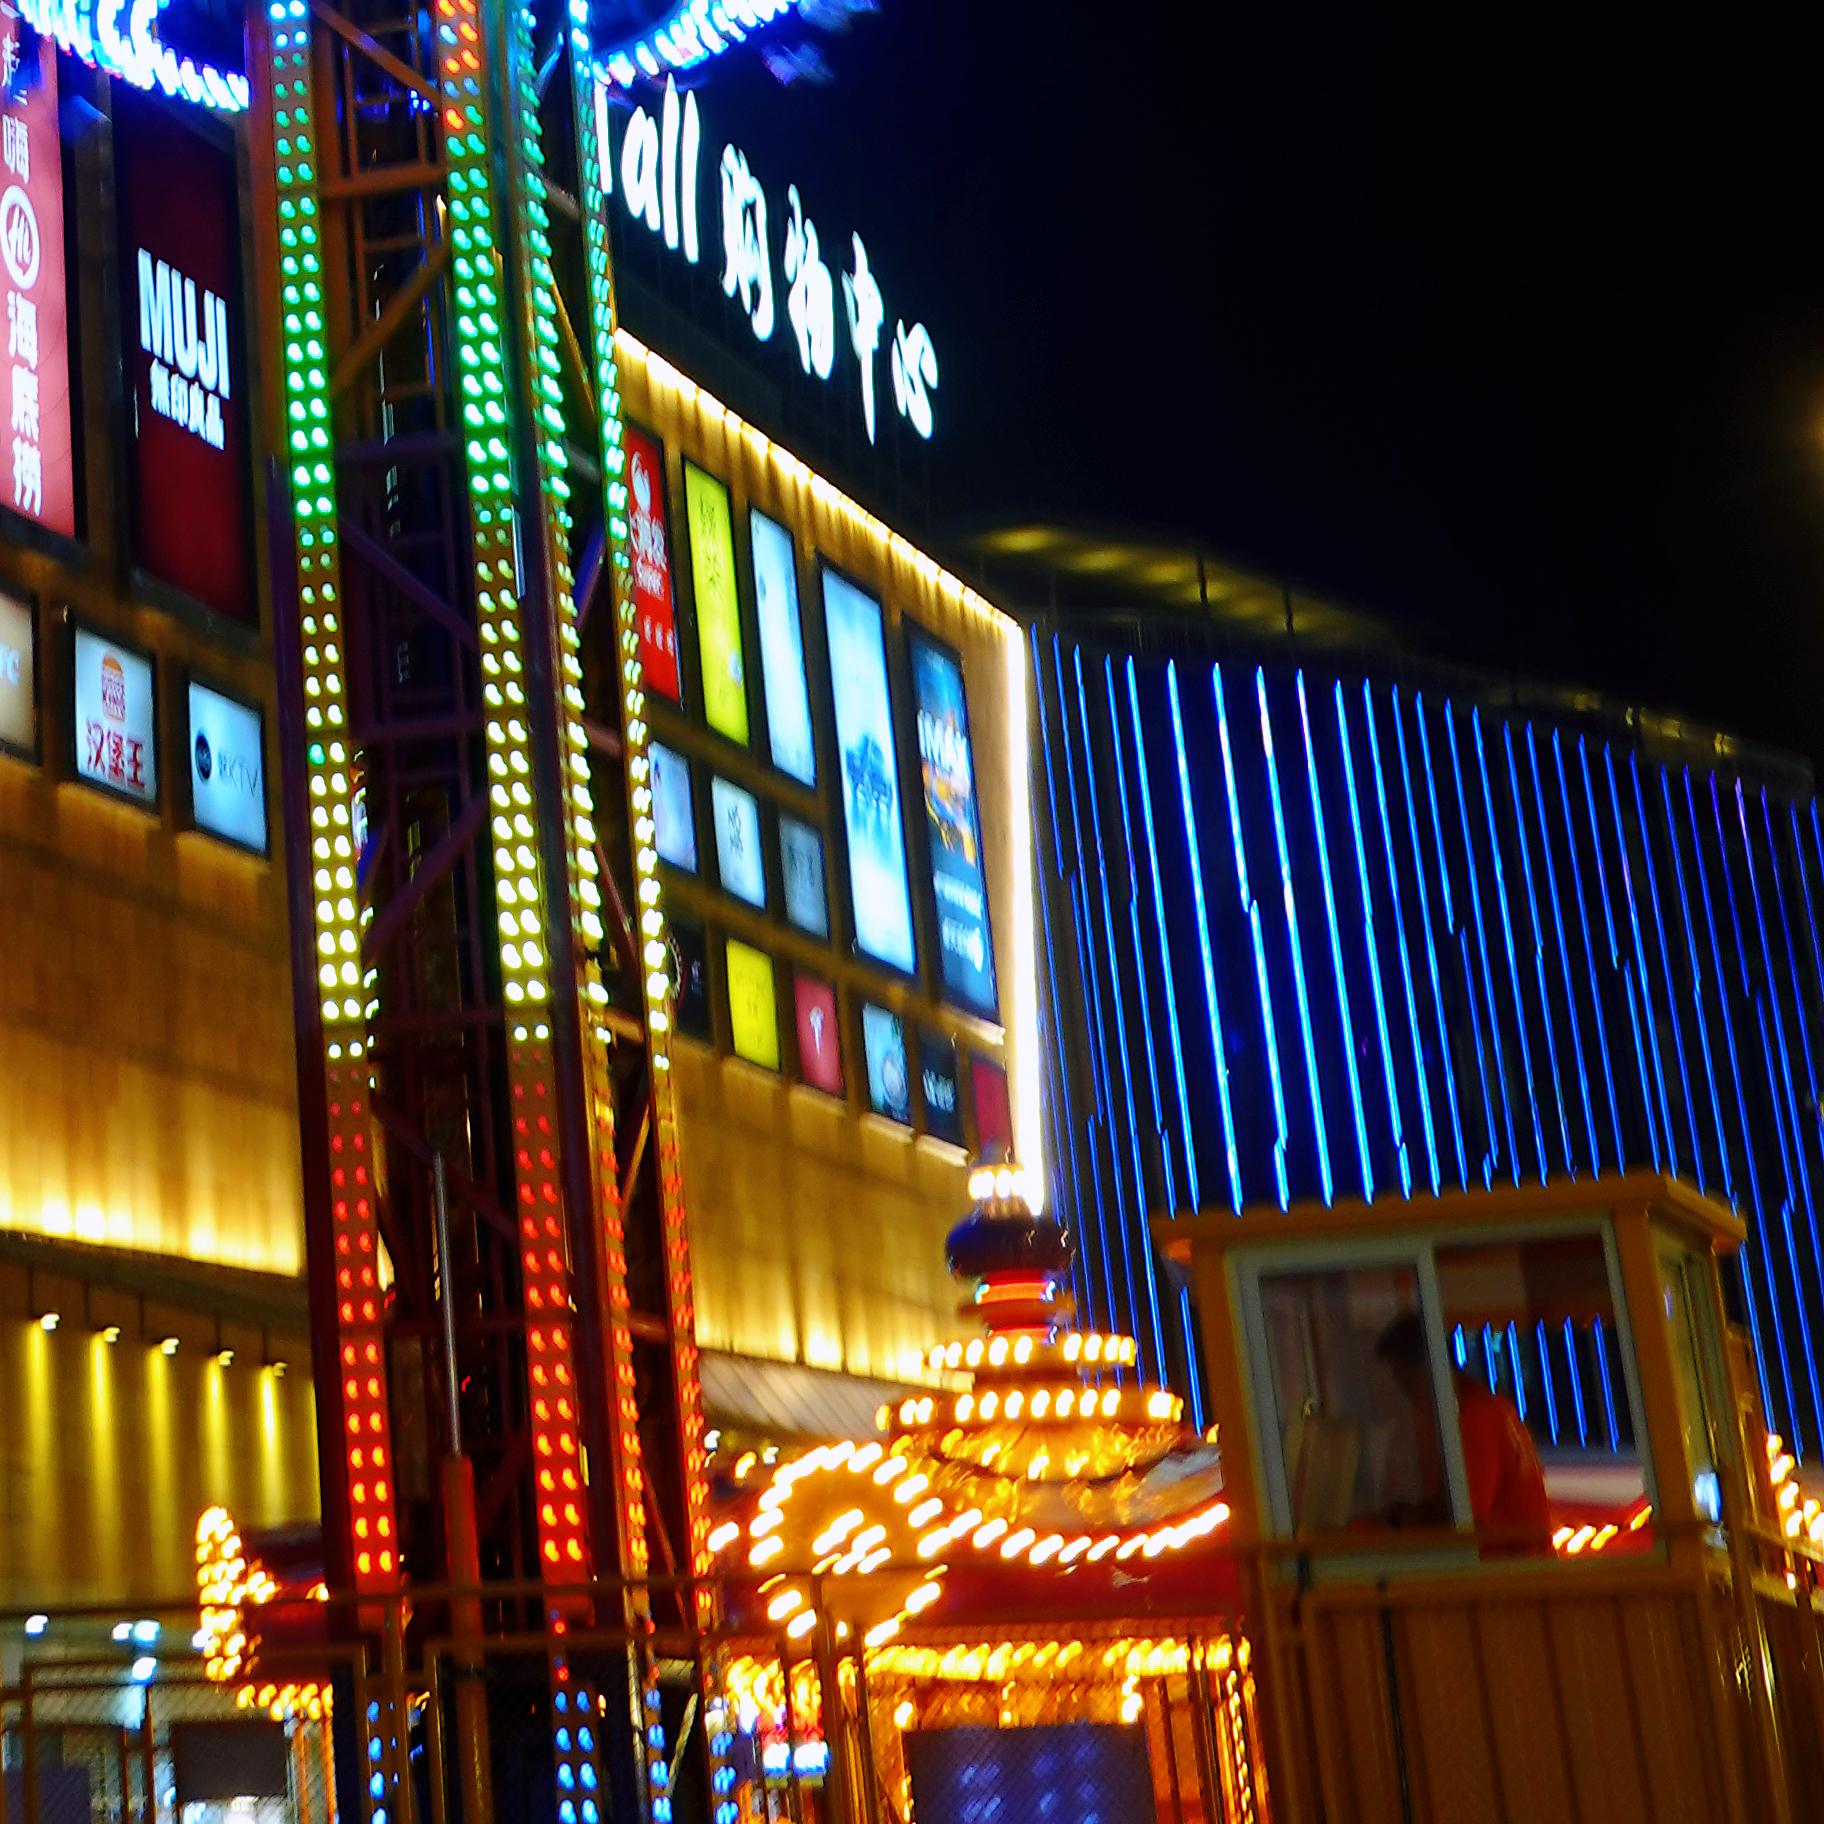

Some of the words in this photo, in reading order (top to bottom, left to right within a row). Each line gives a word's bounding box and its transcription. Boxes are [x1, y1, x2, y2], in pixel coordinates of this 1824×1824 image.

[137, 247, 231, 400] MUJI
[595, 73, 700, 263] all
[720, 143, 939, 446] 购物中心
[8, 289, 43, 518] 海底捞
[86, 718, 145, 790] 汉堡王
